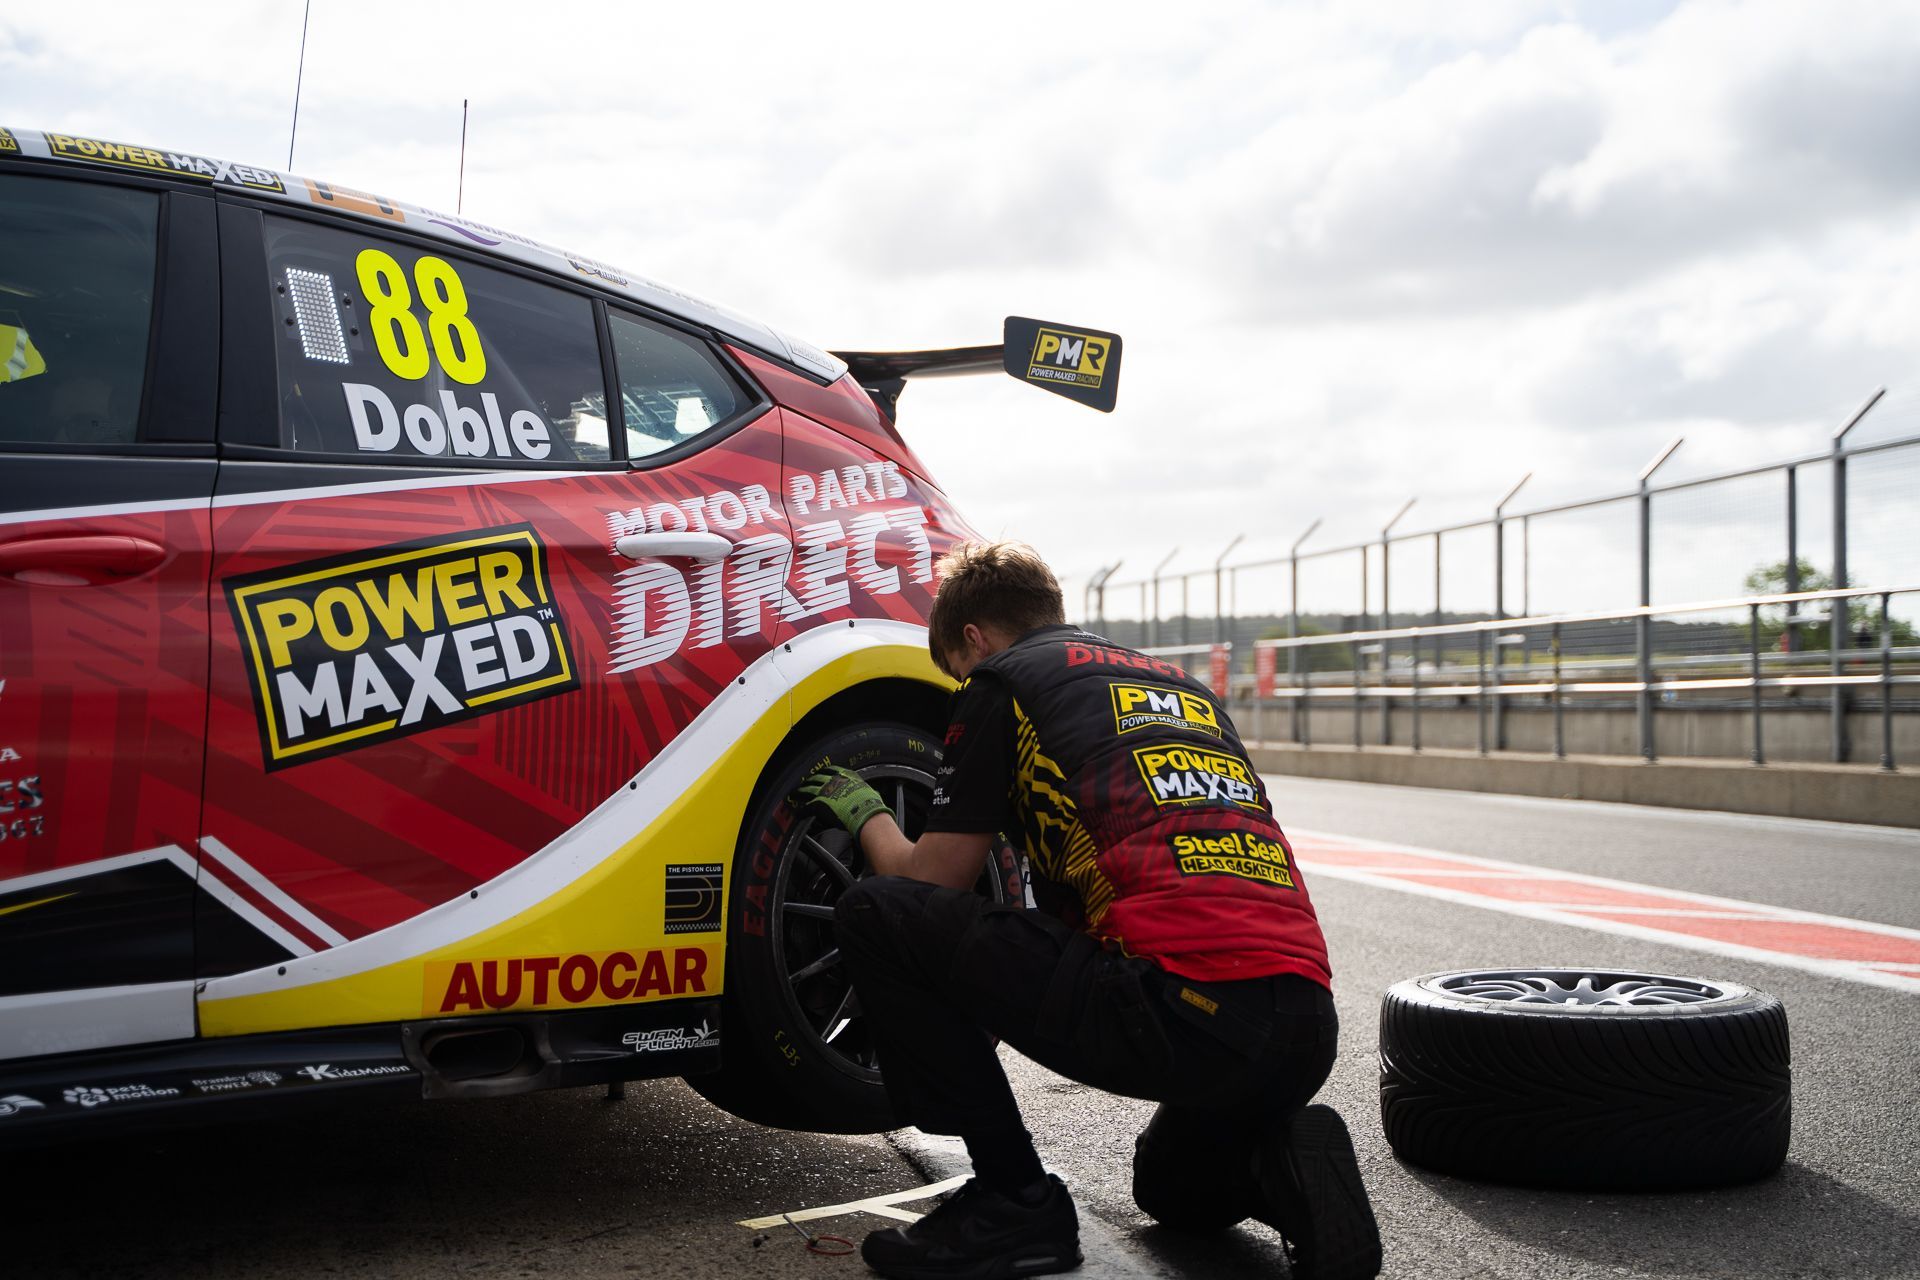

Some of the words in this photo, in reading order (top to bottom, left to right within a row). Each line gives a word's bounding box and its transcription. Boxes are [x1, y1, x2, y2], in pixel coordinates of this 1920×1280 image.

[54, 134, 169, 168] POWER
[168, 152, 276, 185] MAXED
[355, 249, 487, 385] 88
[1036, 334, 1105, 370] PMR
[1030, 367, 1054, 379] POWER
[1054, 370, 1077, 382] MAXED
[1076, 373, 1100, 385] RACING
[342, 382, 551, 460] Doble
[604, 484, 784, 556] MOTOR
[789, 460, 908, 515] PARTS
[605, 505, 933, 675] DIRECT
[256, 551, 535, 668] POWER
[276, 614, 551, 740] MAXED
[1066, 646, 1186, 680] DIRECT
[1117, 687, 1210, 722] PMR
[1121, 715, 1158, 730] POWER
[1158, 716, 1188, 728] MAXED
[1189, 721, 1219, 737] RACING
[1142, 749, 1252, 786] POWER
[1151, 771, 1256, 803] MAXED
[1173, 832, 1246, 856] Steel
[1244, 833, 1289, 867] Seal
[668, 866, 681, 874] THE
[705, 865, 722, 873] CLUB
[743, 799, 795, 937] EAGLE
[1183, 857, 1226, 872] HEAD
[1225, 859, 1273, 877] GASKET
[1273, 868, 1290, 883] FIX
[439, 947, 708, 1013] AUTOCAR
[622, 1027, 685, 1045] SWAN
[112, 1086, 180, 1101] motion
